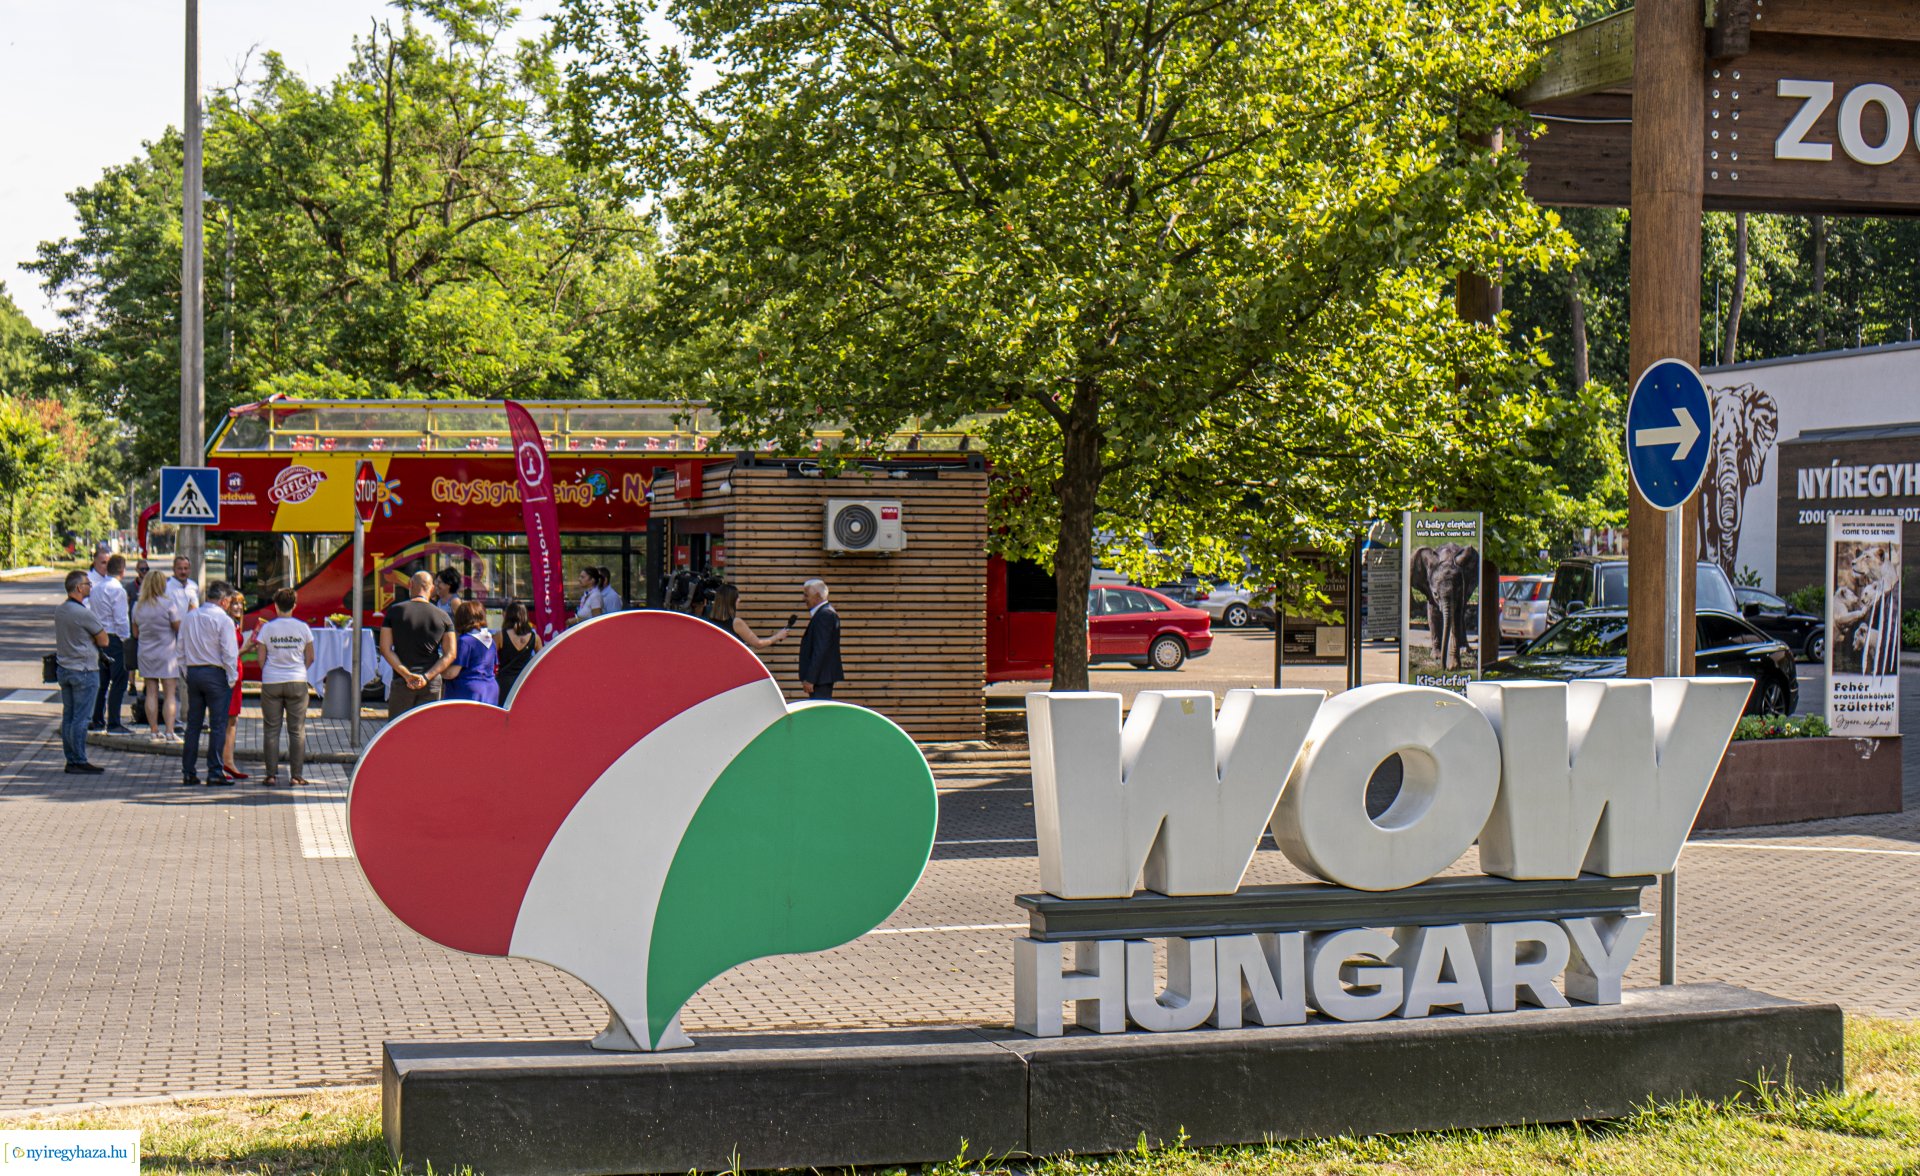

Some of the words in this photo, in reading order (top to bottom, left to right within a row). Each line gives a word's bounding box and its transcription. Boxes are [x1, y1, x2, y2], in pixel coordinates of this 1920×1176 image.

[1775, 79, 1920, 165] ZO
[274, 471, 325, 499] OFFICIAL
[1798, 459, 1920, 499] NYÍREGYH
[219, 492, 256, 501] orldwide
[291, 487, 313, 501] TOUR
[355, 480, 376, 502] STOP
[432, 476, 593, 507] CitySighteing
[1898, 507, 1920, 522] BOT
[1416, 520, 1423, 529] A
[1425, 520, 1445, 530] baby
[1447, 520, 1476, 530] elephant
[1416, 674, 1472, 687] Kiselefánt
[1834, 682, 1869, 692] Fehér
[1834, 701, 1894, 711] születtek!
[1026, 677, 1756, 899] WOW
[1014, 912, 1656, 1037] HUNGARY
